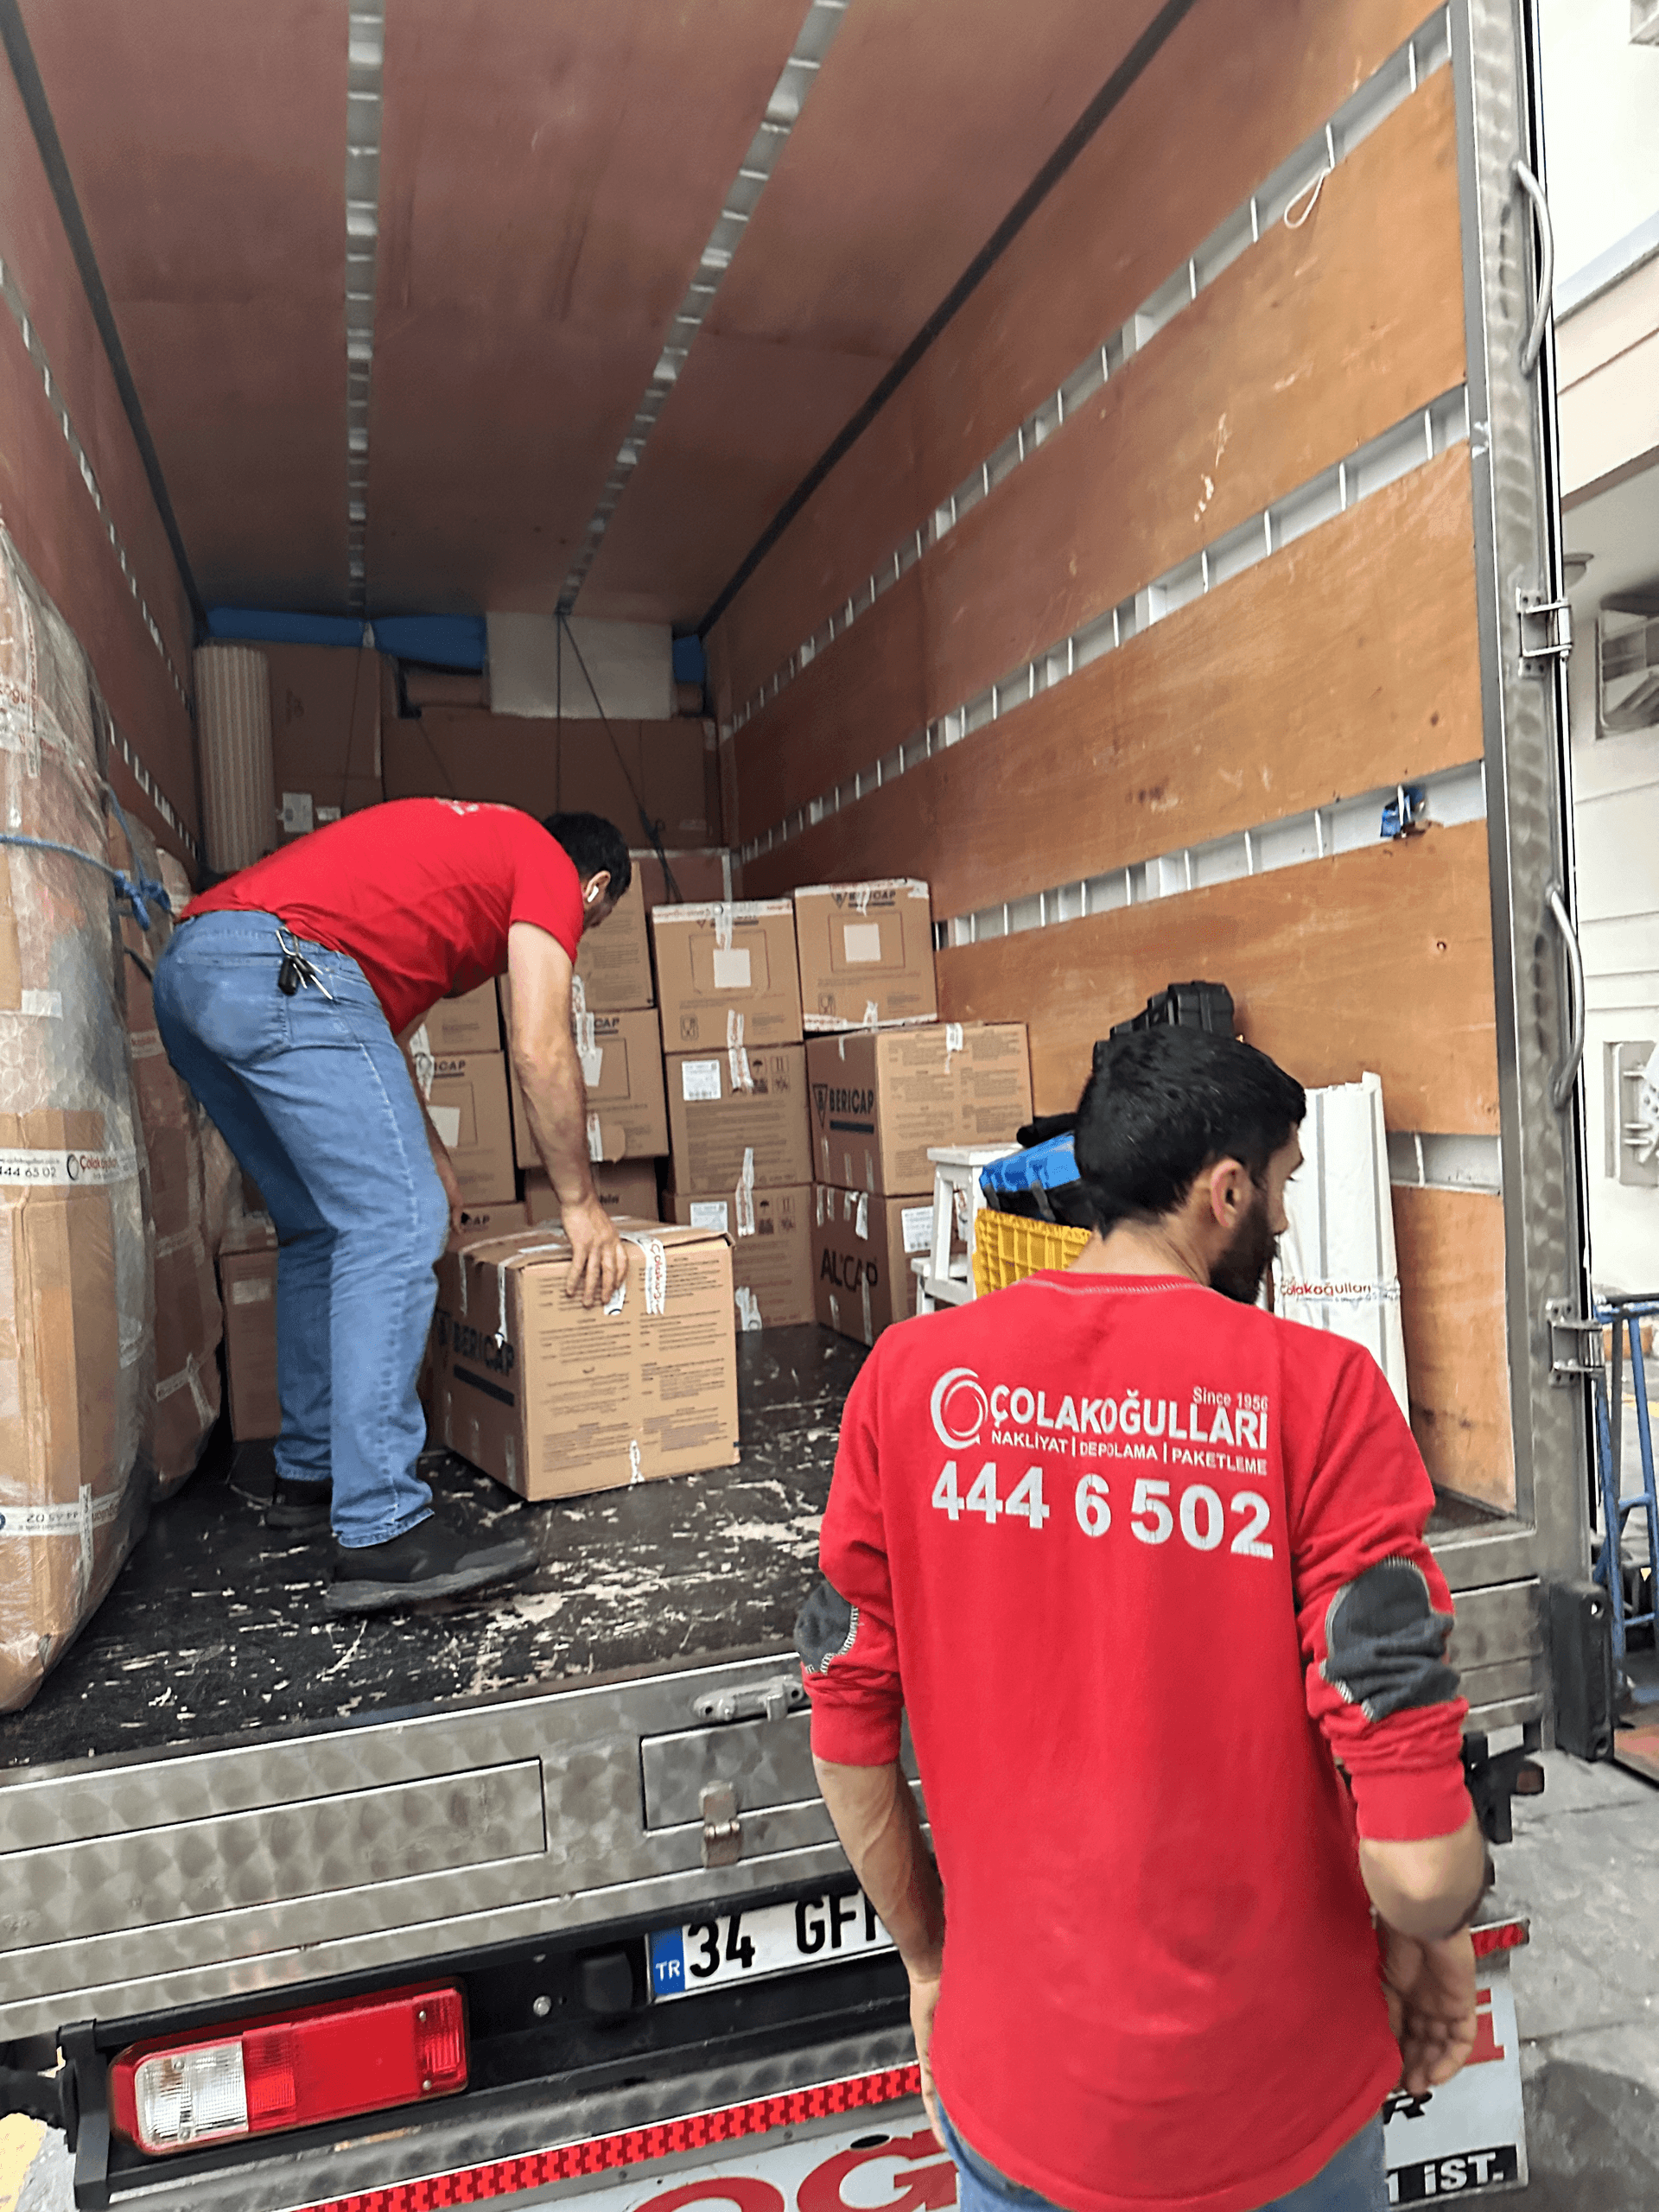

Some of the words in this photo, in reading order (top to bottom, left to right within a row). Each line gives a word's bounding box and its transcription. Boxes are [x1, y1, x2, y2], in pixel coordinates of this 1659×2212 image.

[830, 1089, 874, 1115] BERICAP
[1192, 1385, 1232, 1408] Since
[990, 1384, 1268, 1450] ÇOLAKOĞULLARI
[1079, 1444, 1159, 1461] DEPOLAMA
[1172, 1446, 1268, 1476] PAKETLEME
[931, 1460, 1051, 1529] 444
[1074, 1473, 1112, 1538] 6
[1130, 1478, 1274, 1560] 502
[688, 1915, 756, 1979] 34
[655, 1959, 681, 1981] TR
